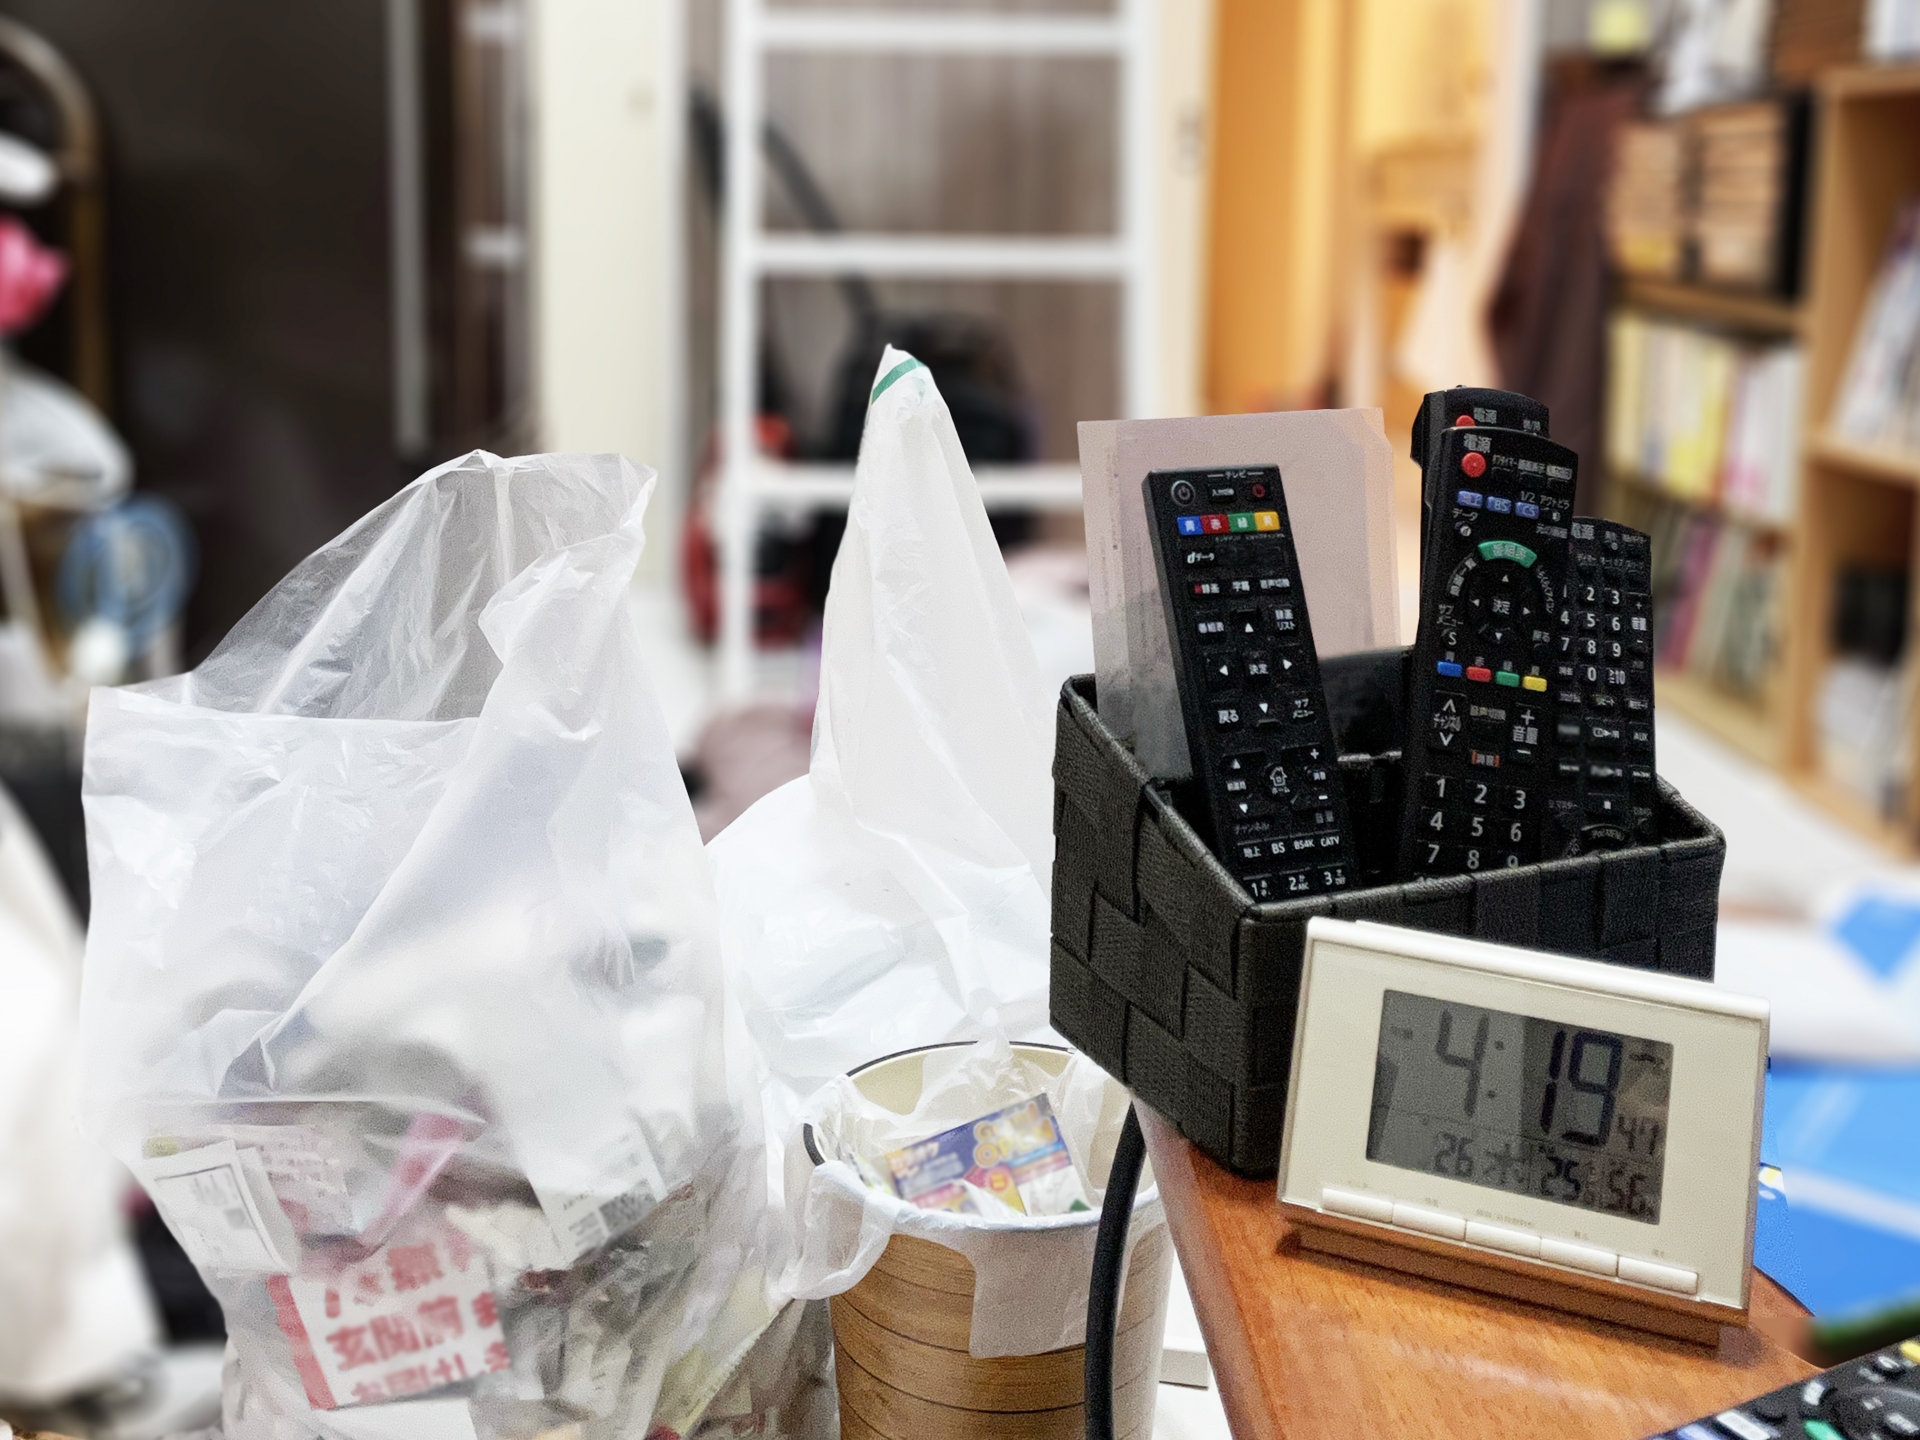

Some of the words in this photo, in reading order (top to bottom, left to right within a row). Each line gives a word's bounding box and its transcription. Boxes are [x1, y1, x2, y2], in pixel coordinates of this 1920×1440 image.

[1474, 408, 1497, 423] 電源
[1464, 433, 1492, 453] 電源
[1494, 500, 1509, 512] BS
[1522, 505, 1536, 517] CS
[1452, 508, 1478, 521] データ
[1563, 585, 1568, 598] 1
[1586, 587, 1595, 601] 2
[1611, 590, 1620, 605] 3
[1560, 610, 1570, 625] 4
[1587, 613, 1596, 627] 5
[1611, 617, 1621, 631] 6
[1561, 637, 1570, 651] 7
[1588, 640, 1596, 654] 8
[1612, 642, 1621, 657] 9
[1587, 667, 1596, 681] 0
[1218, 709, 1239, 724] 戻る
[1513, 725, 1538, 745] 音量
[1437, 778, 1446, 798] 1
[1474, 784, 1488, 804] 2
[1514, 790, 1526, 810] 3
[1430, 811, 1443, 831] 4
[1472, 817, 1484, 837] 5
[1510, 823, 1522, 843] 6
[1271, 842, 1285, 854] BS
[1294, 840, 1315, 850] BS4K
[1321, 836, 1340, 847] CATV
[1428, 844, 1440, 864] 7
[1467, 850, 1480, 870] 8
[1289, 877, 1297, 891] 2
[1324, 871, 1332, 886] 3
[1251, 883, 1258, 897] 1
[1435, 1131, 1474, 1178] 26
